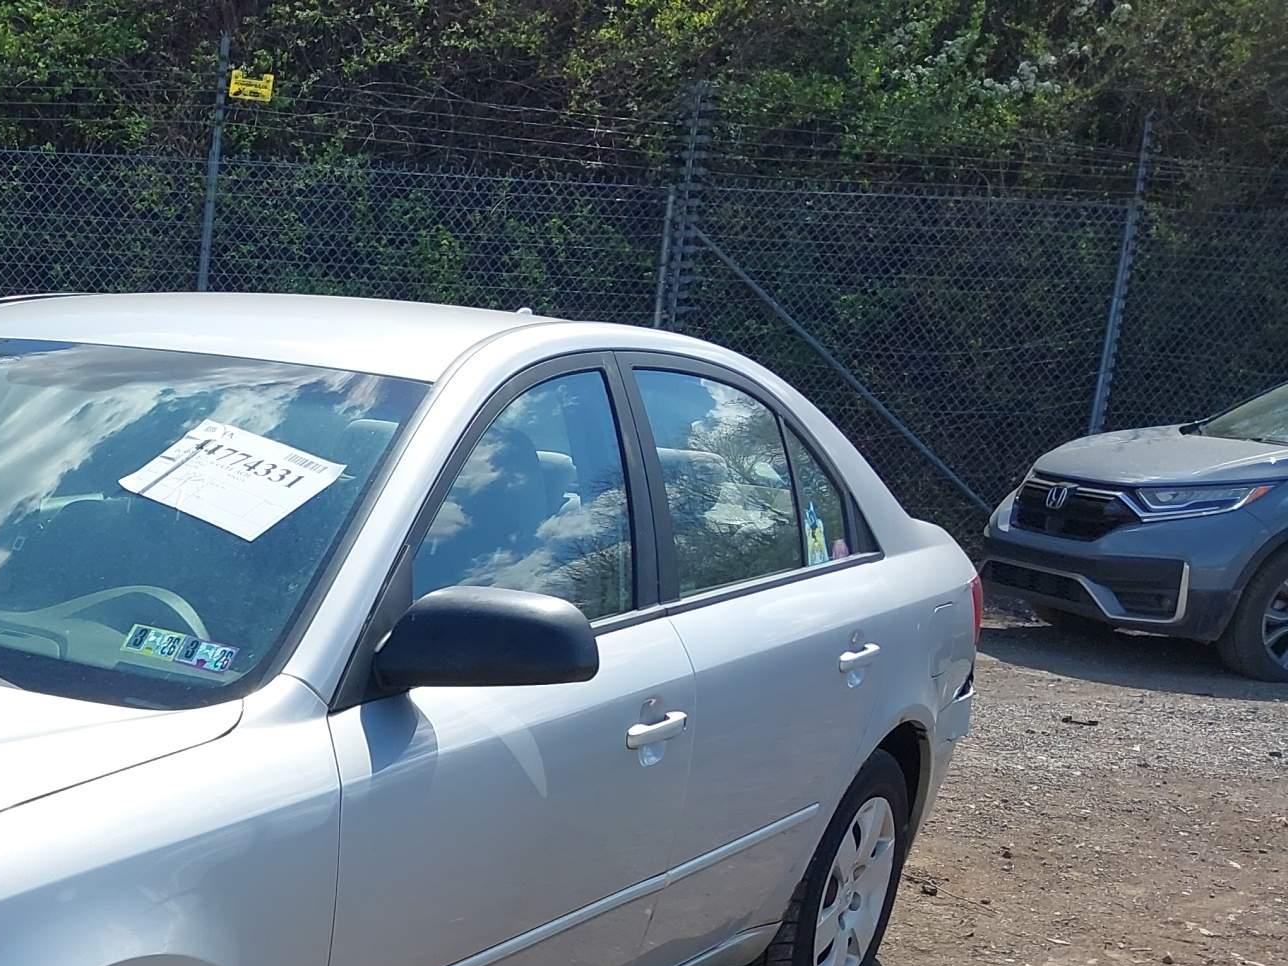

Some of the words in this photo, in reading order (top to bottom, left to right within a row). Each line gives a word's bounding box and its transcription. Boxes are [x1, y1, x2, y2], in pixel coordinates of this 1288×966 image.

[195, 438, 306, 489] 44774331
[133, 628, 149, 647] 3
[160, 636, 181, 656] 26
[184, 640, 200, 659] 3
[214, 649, 234, 670] 26
